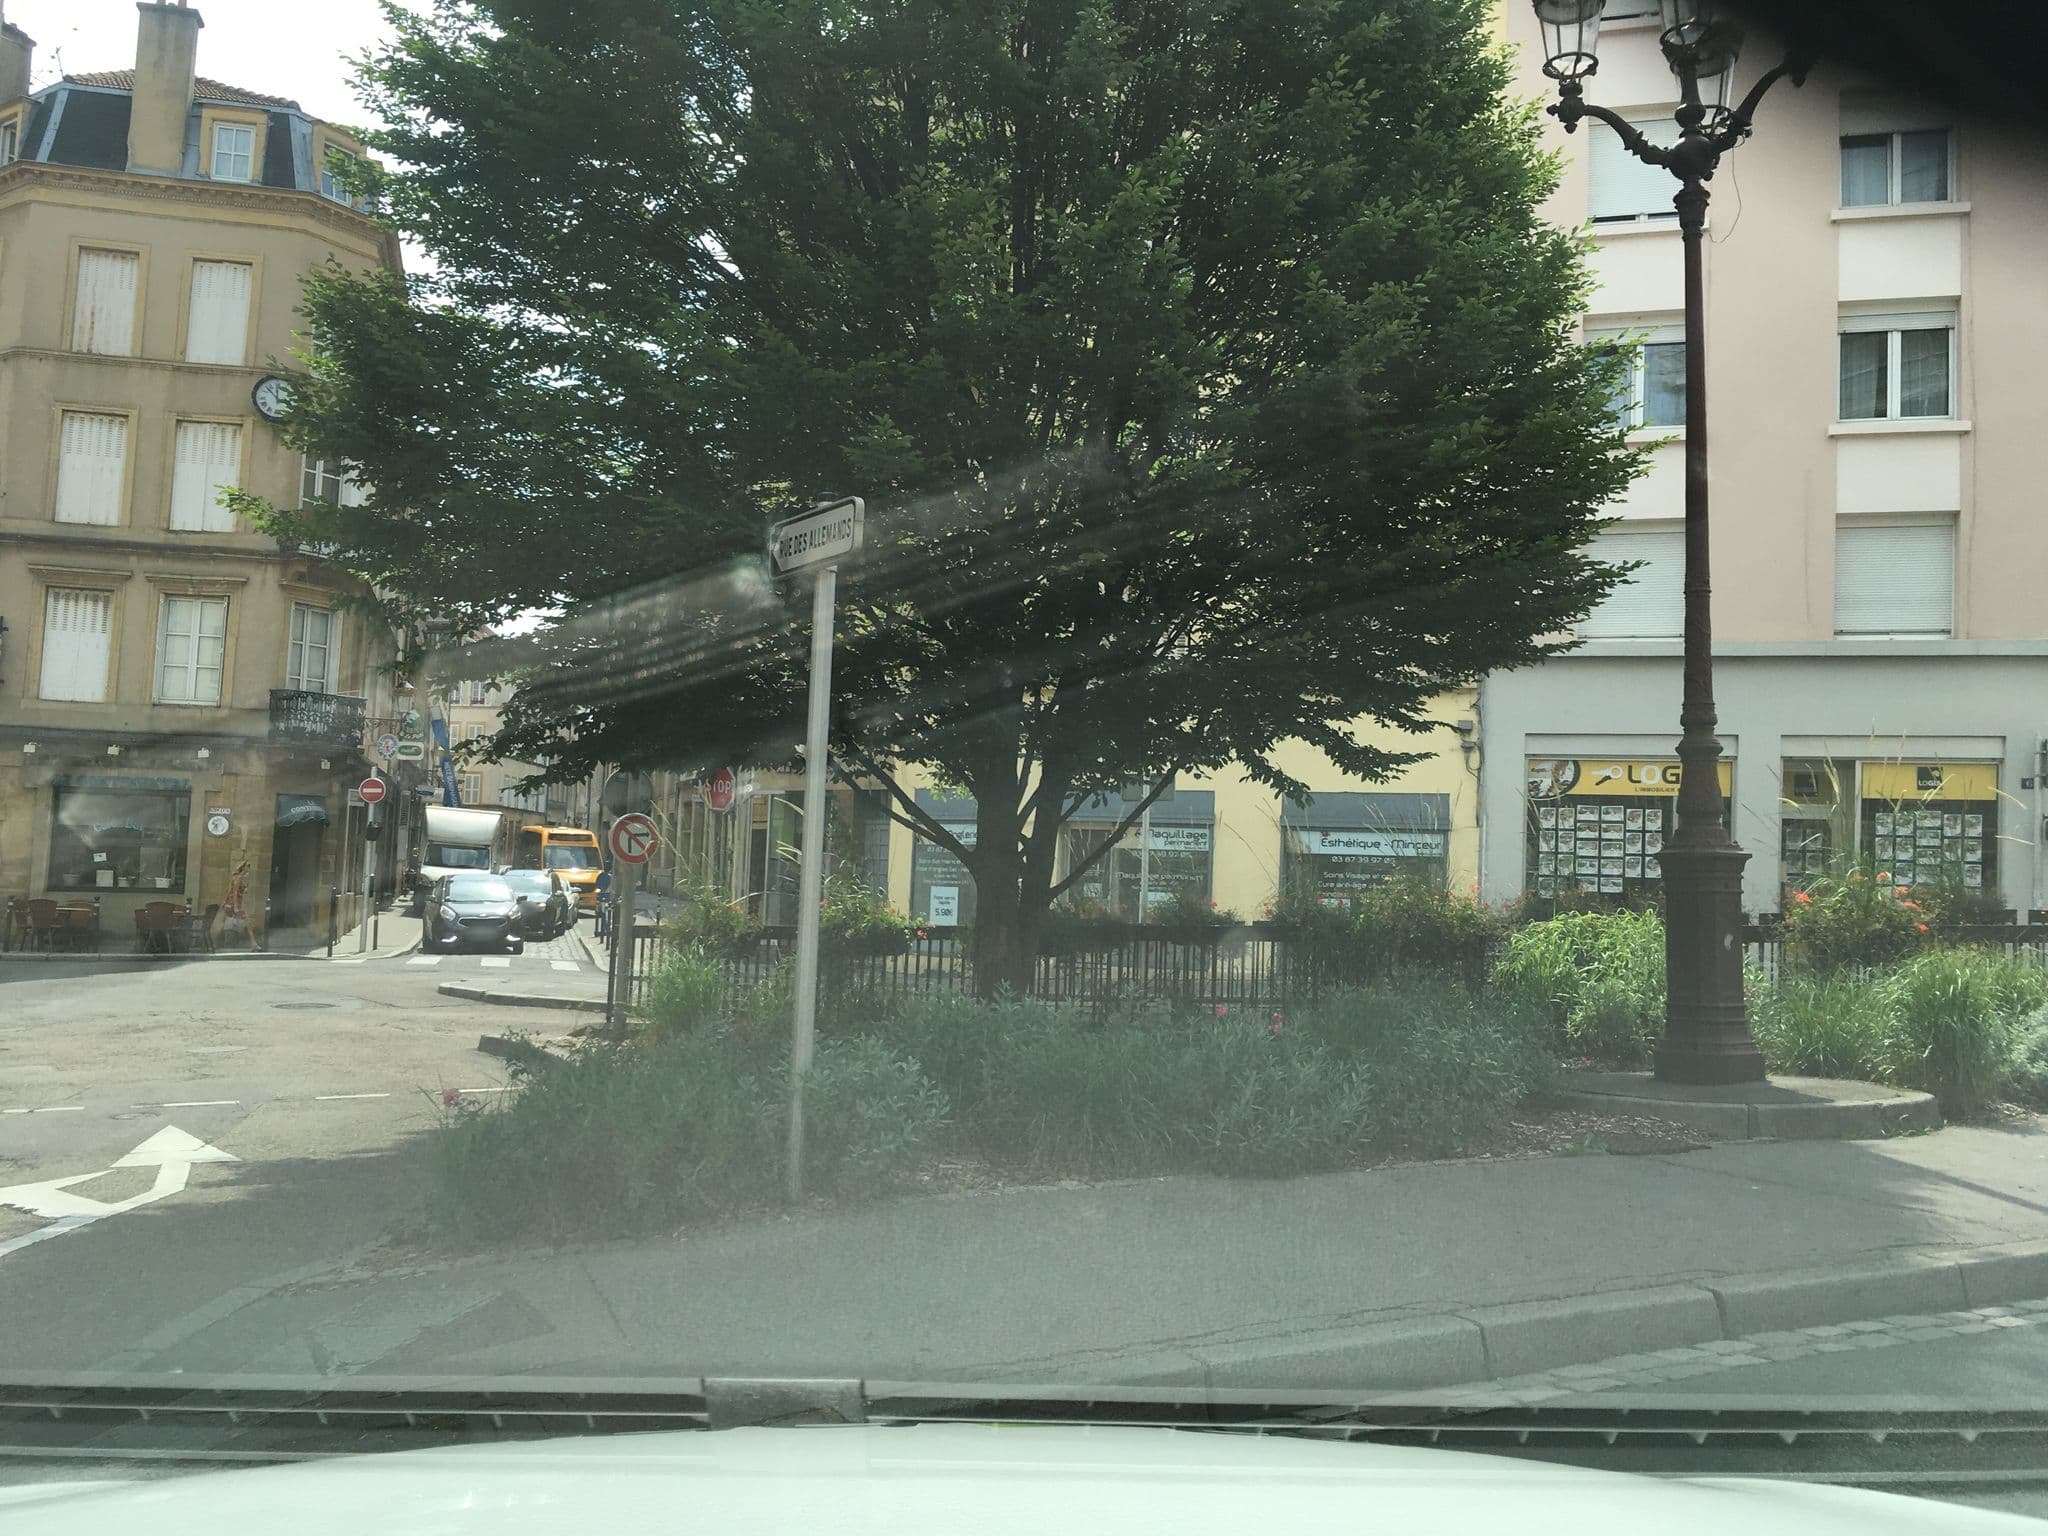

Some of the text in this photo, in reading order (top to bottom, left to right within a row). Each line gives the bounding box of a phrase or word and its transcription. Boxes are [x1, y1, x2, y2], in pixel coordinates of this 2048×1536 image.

[779, 518, 852, 559] RUE DES ALLEMANDS
[1627, 764, 1681, 784] LOG
[1321, 837, 1382, 852] Esthétique
[1390, 839, 1441, 850] Minceur
